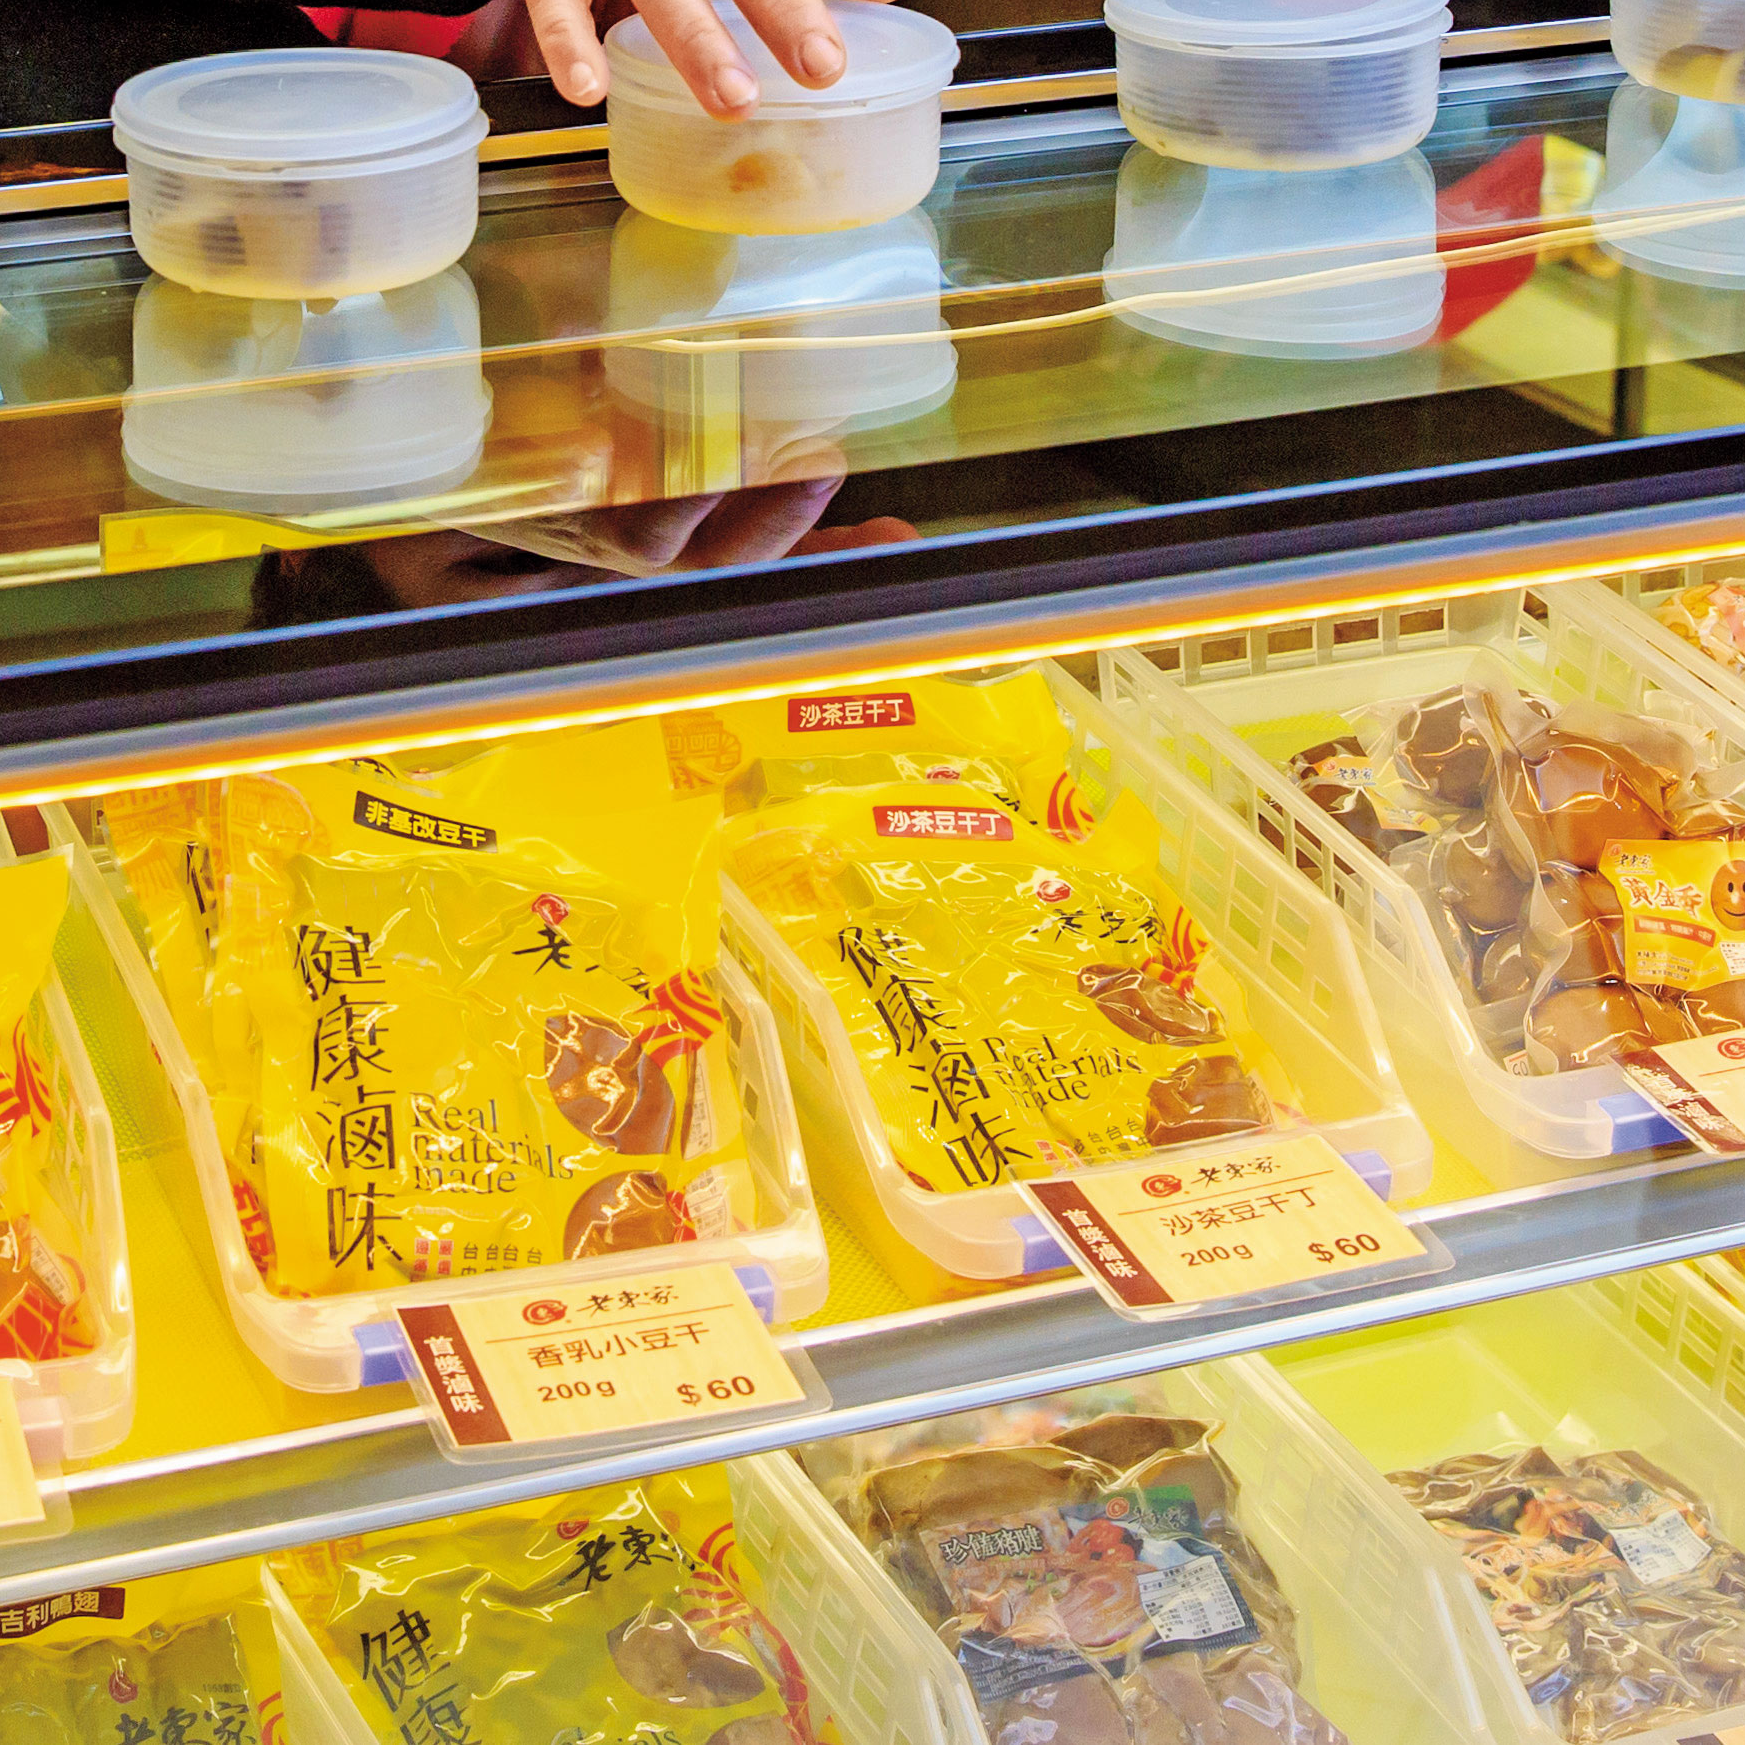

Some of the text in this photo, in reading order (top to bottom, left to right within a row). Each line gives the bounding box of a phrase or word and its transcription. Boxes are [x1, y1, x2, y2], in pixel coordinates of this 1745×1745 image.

[799, 699, 904, 727] 沙茶豆干丁
[364, 802, 488, 849] 非基改豆干
[885, 809, 1002, 837] 沙茶豆干丁
[1159, 1187, 1318, 1237] 沙茶豆干丁
[1308, 1233, 1381, 1264] $60
[527, 1322, 711, 1369] 香乳小豆干
[676, 1375, 756, 1407] $60
[0, 1591, 100, 1635] 吉利鴨翅
